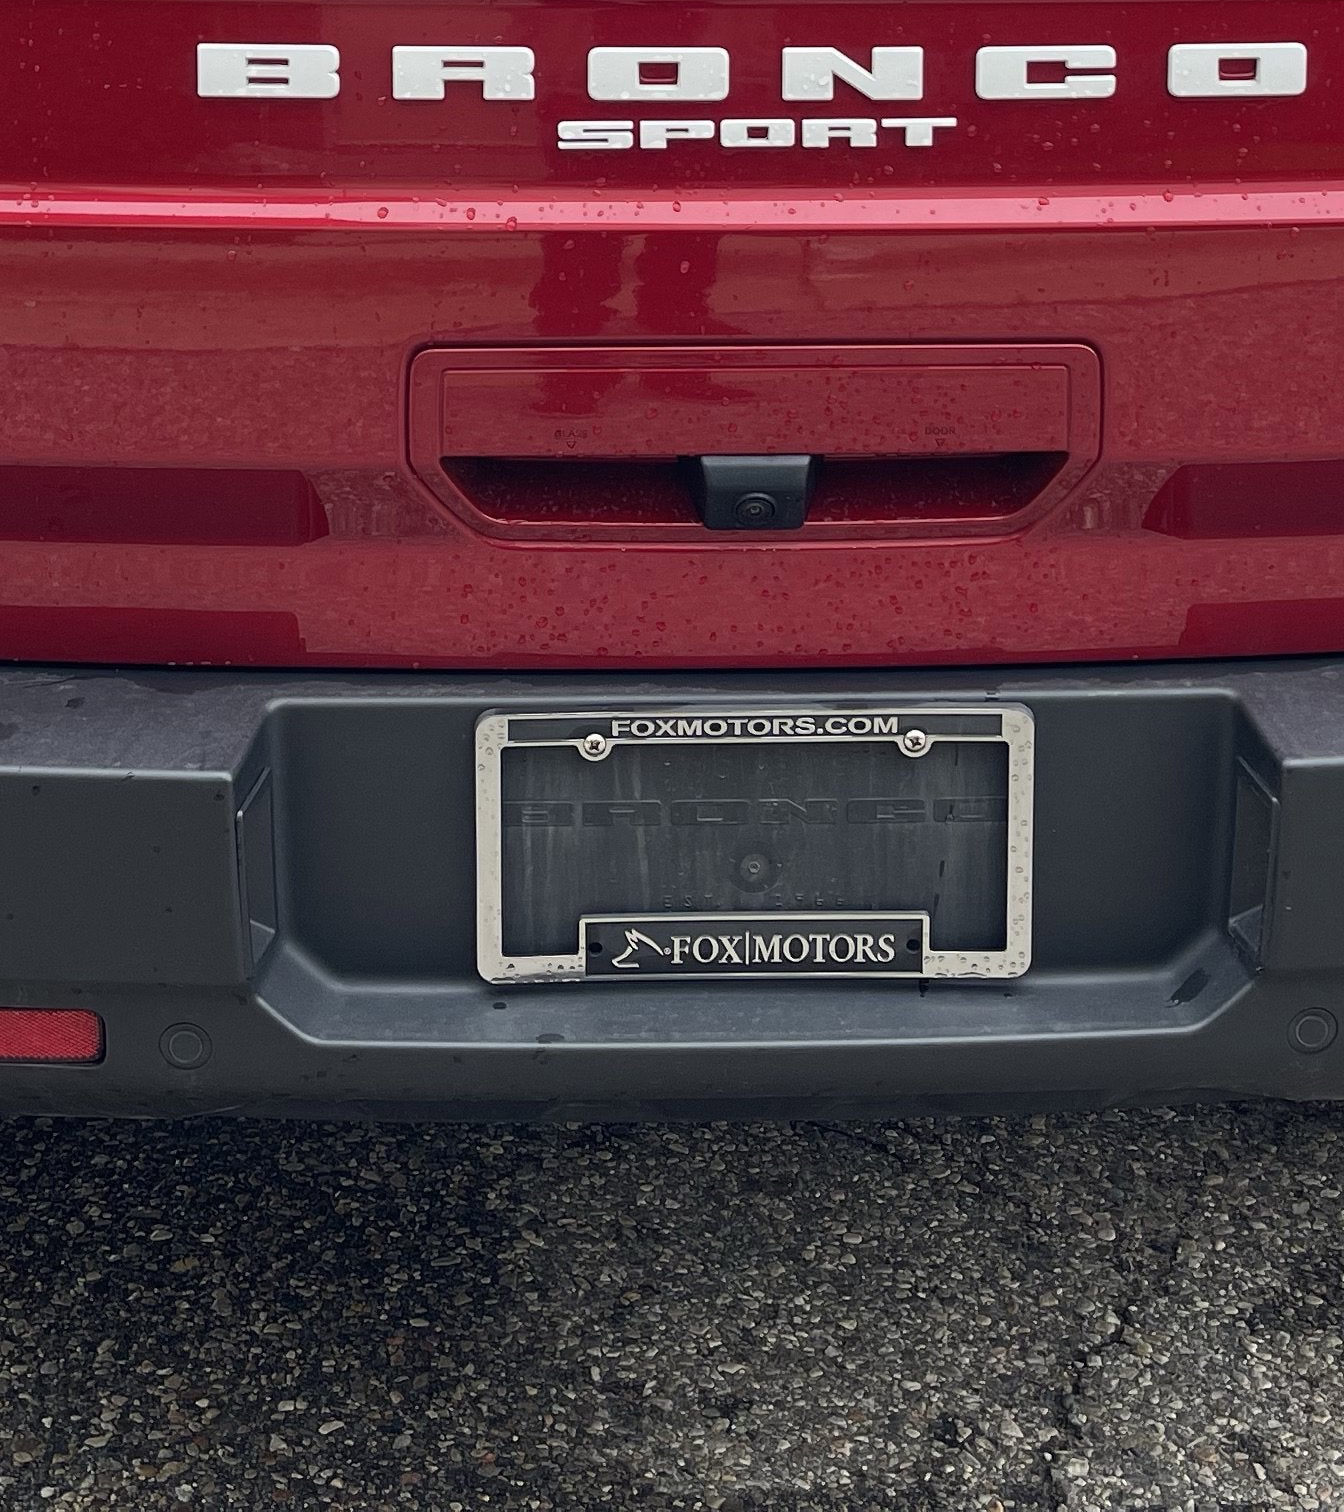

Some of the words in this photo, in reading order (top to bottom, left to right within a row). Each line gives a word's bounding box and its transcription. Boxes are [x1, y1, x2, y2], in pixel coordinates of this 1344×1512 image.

[196, 42, 1308, 101] BRONCO
[557, 117, 958, 150] SPORT
[611, 717, 899, 737] FOXMOTORS.COM
